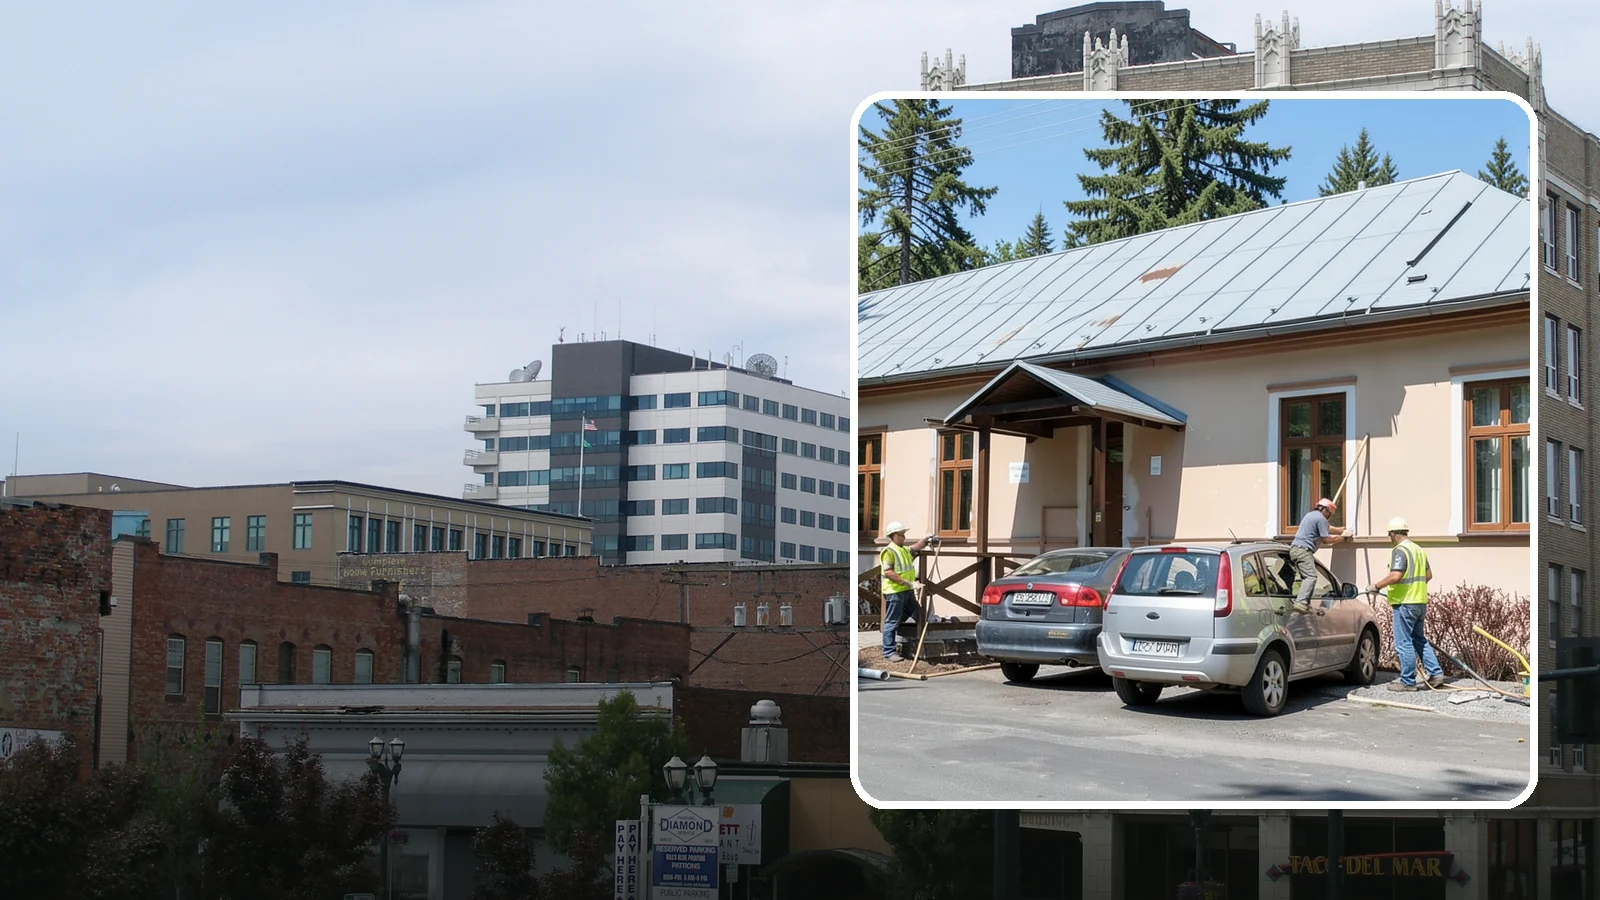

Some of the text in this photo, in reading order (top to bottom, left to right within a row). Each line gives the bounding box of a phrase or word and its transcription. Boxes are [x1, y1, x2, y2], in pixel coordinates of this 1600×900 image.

[370, 566, 427, 577] Furnishers
[660, 818, 713, 833] DIAMOND
[1021, 815, 1069, 828] BUILDING
[656, 845, 716, 854] RESERVED PARKING
[616, 825, 625, 893] PAY HERE
[627, 824, 636, 893] PAY HERE
[671, 862, 701, 870] PATRONS
[1346, 855, 1385, 876] DEL
[1392, 857, 1443, 877] MAR
[660, 888, 710, 898] PUBLIC PARKING
